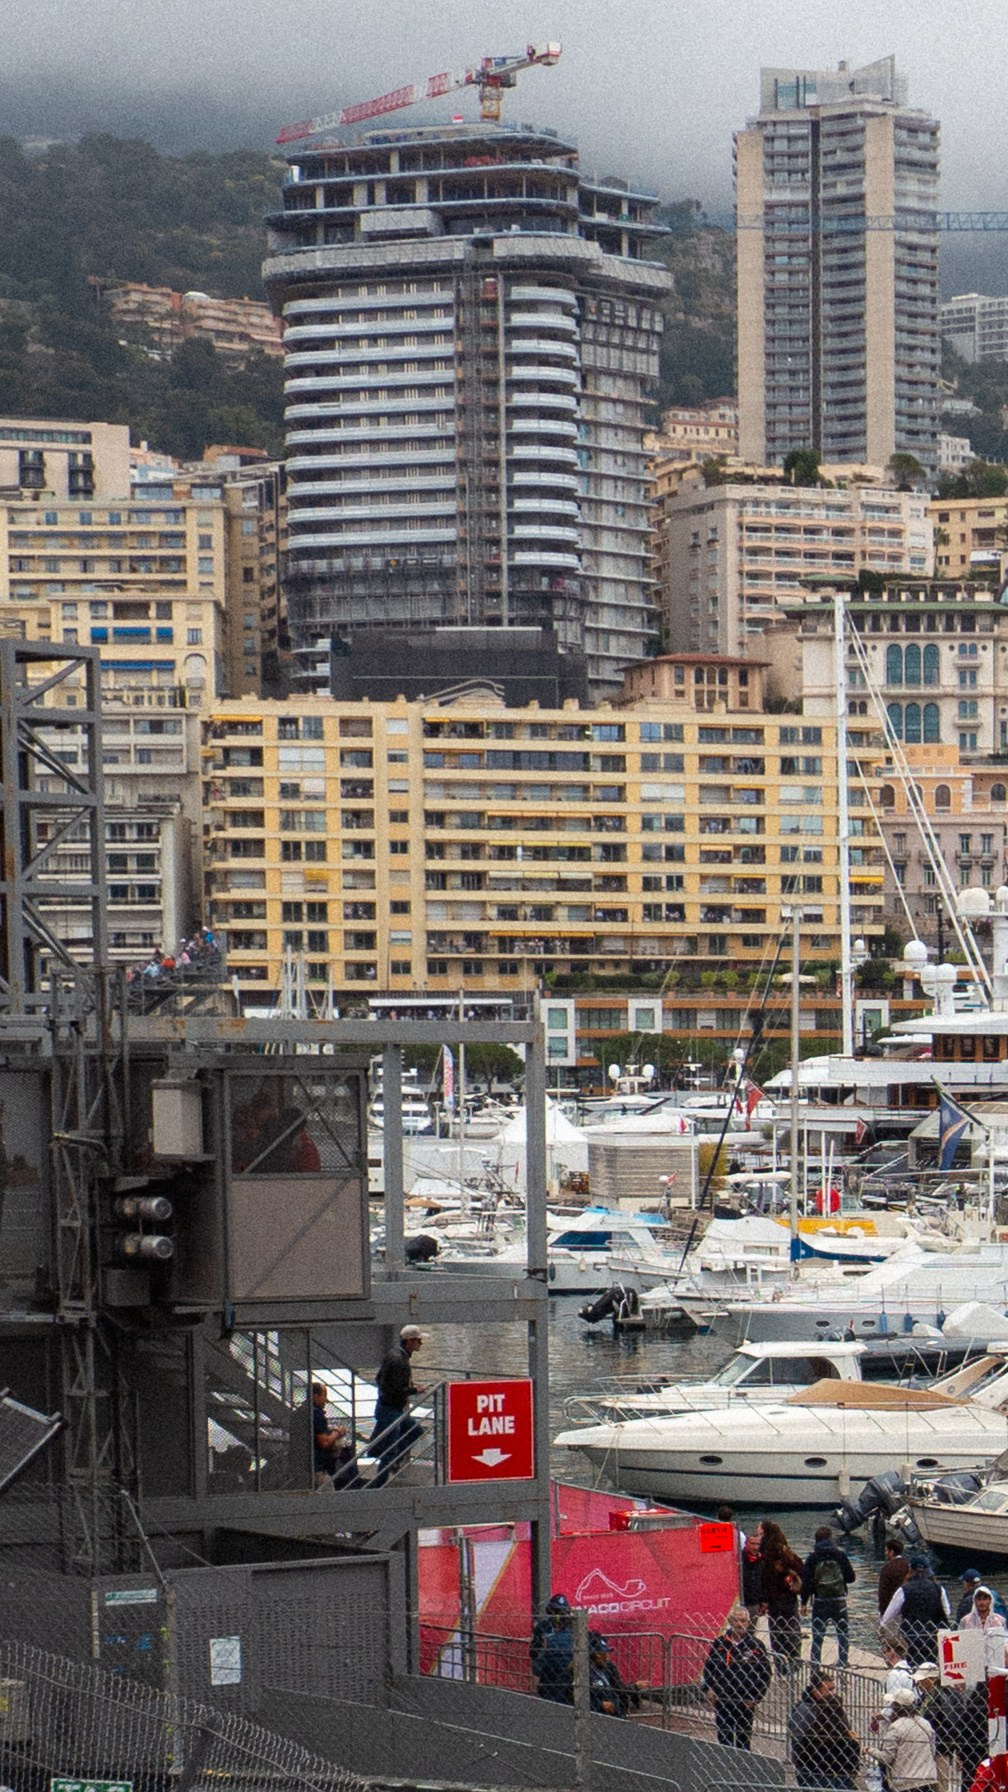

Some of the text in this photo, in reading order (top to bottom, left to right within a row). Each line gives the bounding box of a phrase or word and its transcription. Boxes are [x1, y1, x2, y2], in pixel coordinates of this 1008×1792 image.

[476, 1394, 505, 1413] PIT
[467, 1415, 515, 1436] LANE
[620, 1597, 671, 1611] CIRCUIT
[943, 1661, 967, 1670] FIRE
